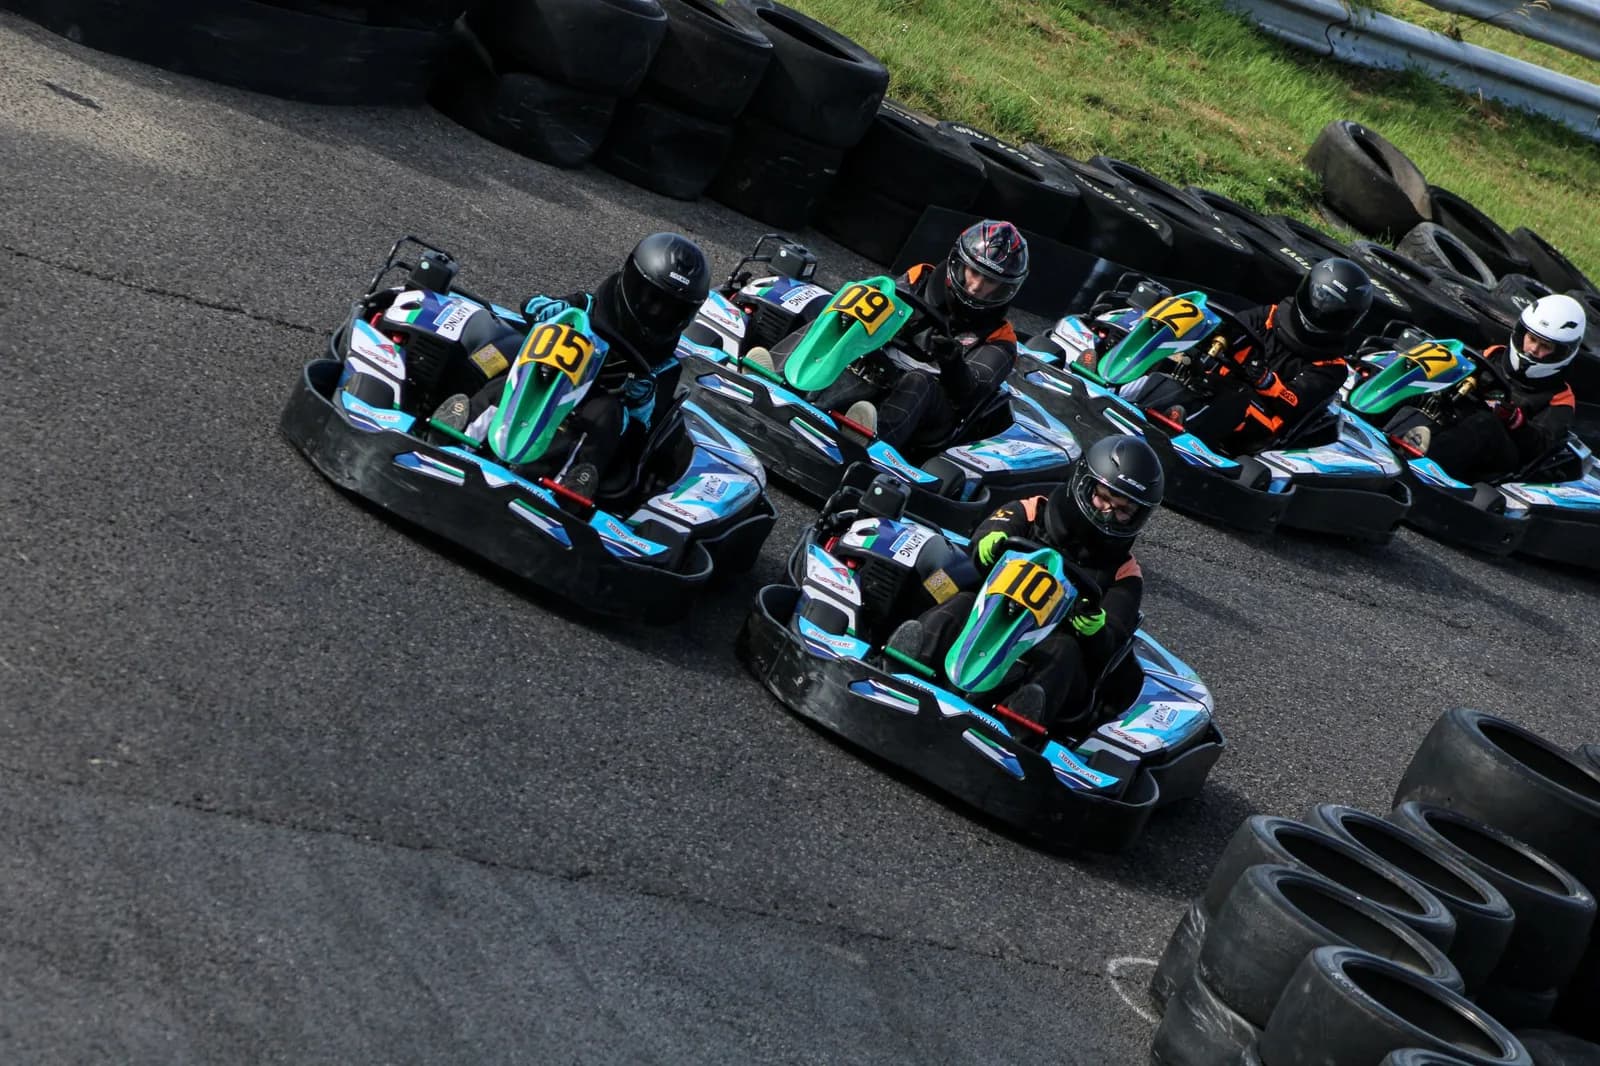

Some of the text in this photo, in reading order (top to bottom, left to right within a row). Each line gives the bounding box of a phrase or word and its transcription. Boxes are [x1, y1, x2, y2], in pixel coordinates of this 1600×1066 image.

[833, 285, 889, 323] 09
[1152, 298, 1199, 331] 12
[526, 324, 592, 373] 05
[1005, 561, 1058, 611] 10
